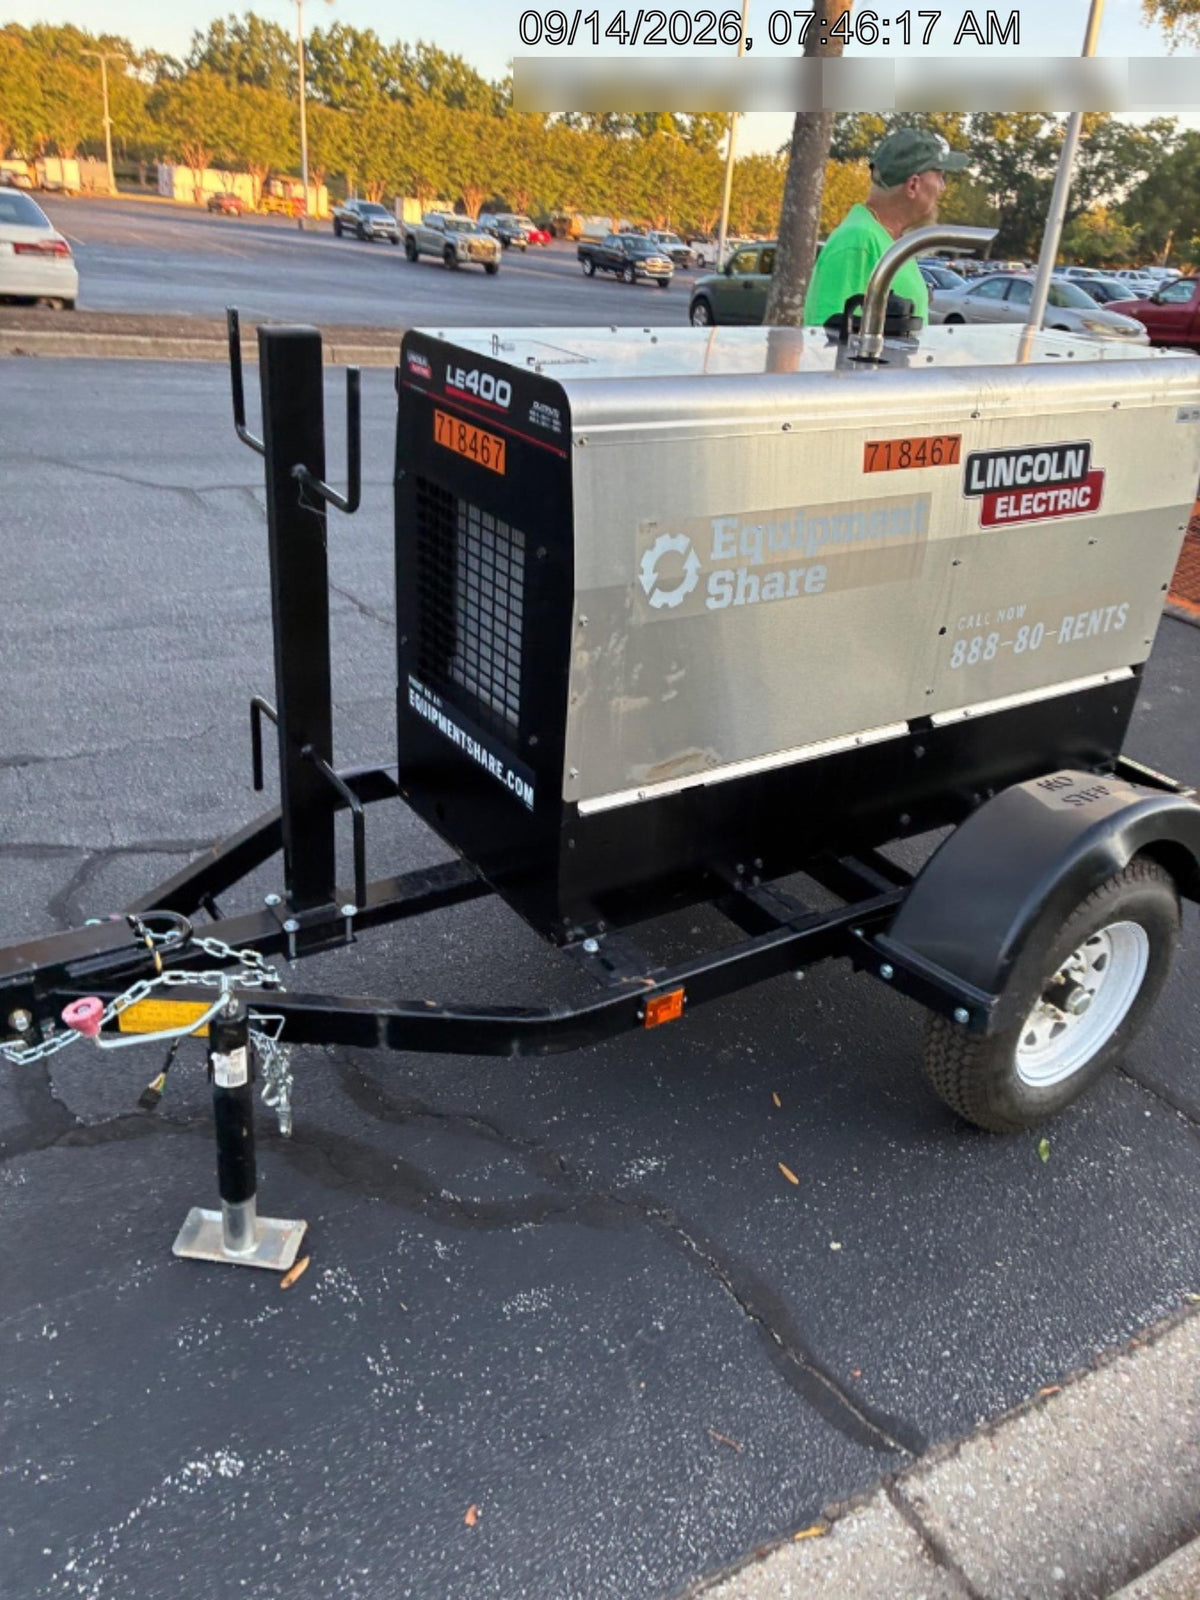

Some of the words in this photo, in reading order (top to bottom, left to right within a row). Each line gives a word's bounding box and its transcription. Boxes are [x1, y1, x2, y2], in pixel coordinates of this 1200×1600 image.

[446, 365, 512, 408] LE400
[436, 414, 503, 470] 718467
[866, 436, 960, 473] 718467
[970, 449, 1085, 491] LINCOLN
[995, 486, 1092, 519] ELECTRIC
[710, 493, 928, 565] Equipment
[705, 564, 827, 610] Share
[949, 602, 1131, 669] 888-80-RENTS
[957, 614, 990, 631] CALL
[999, 604, 1027, 622] NOW
[409, 687, 534, 808] EQUIPMENTSHARE.COM
